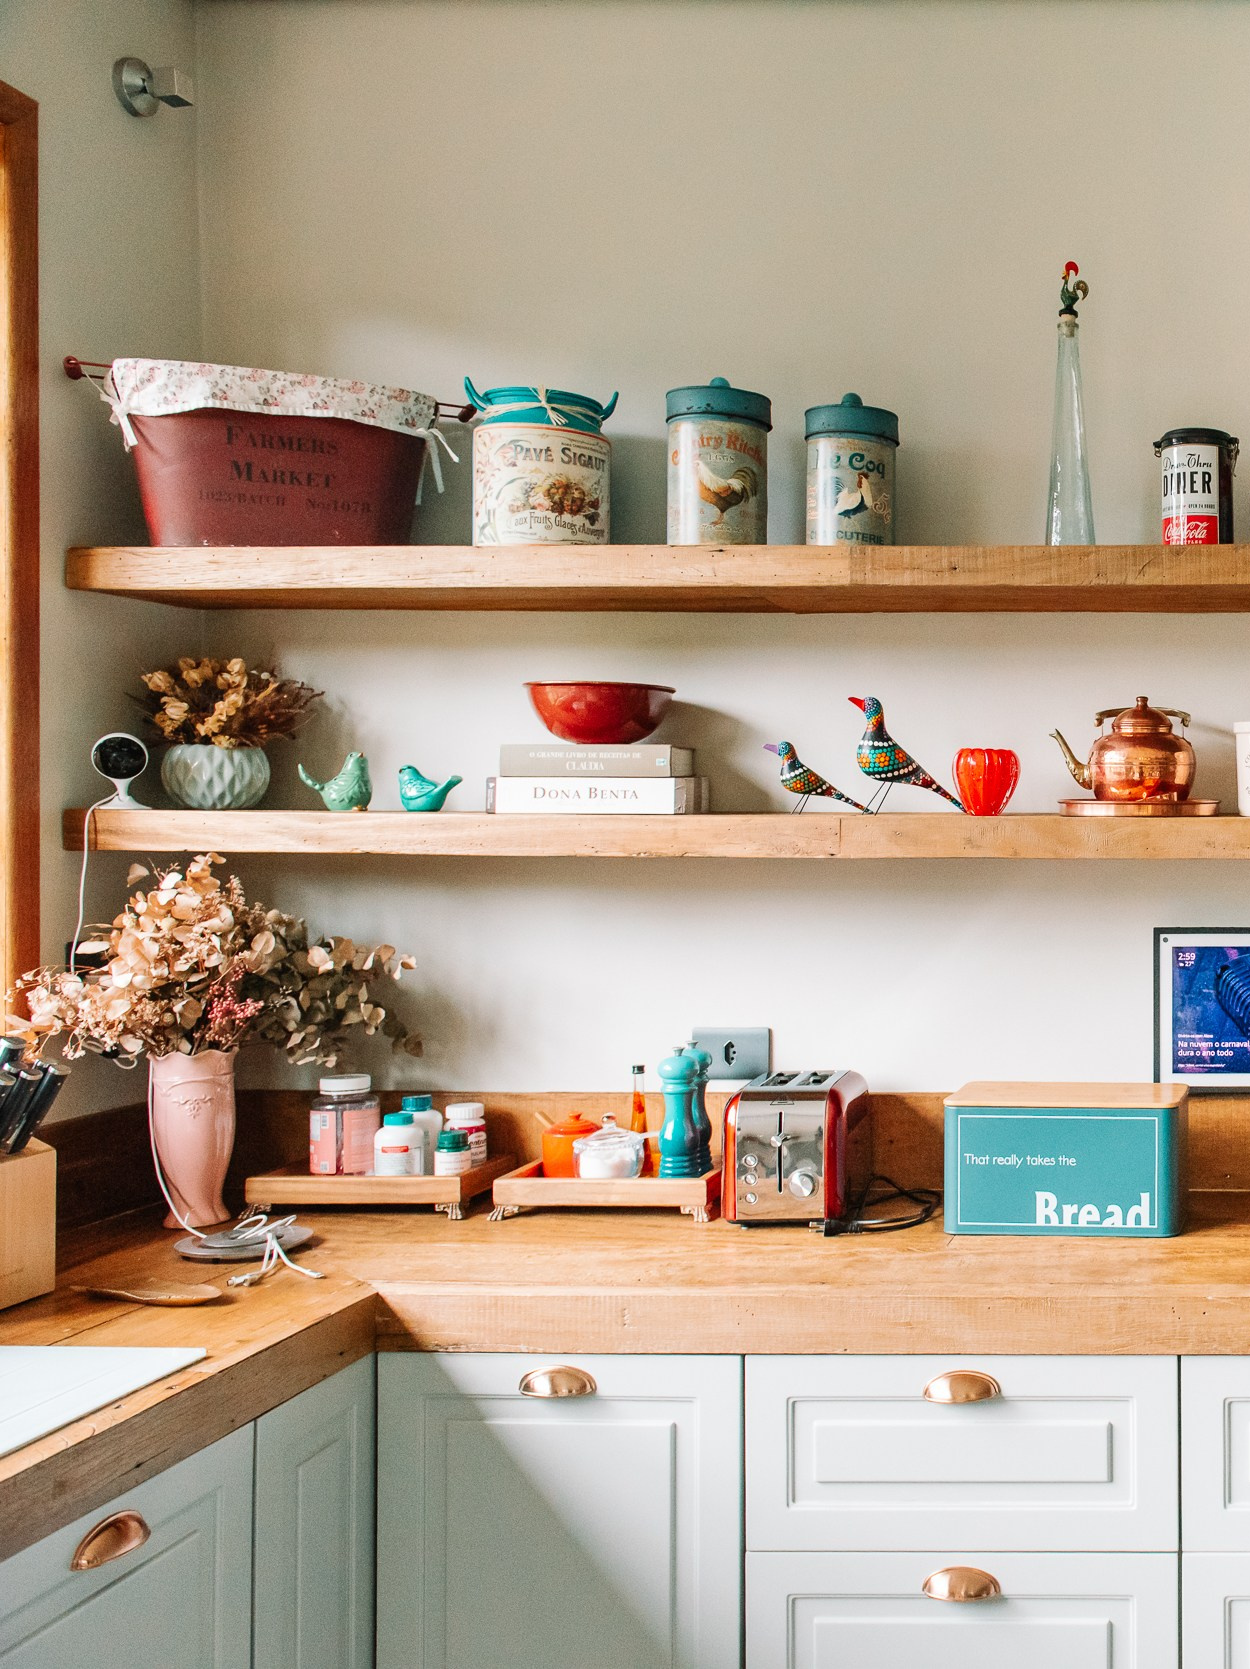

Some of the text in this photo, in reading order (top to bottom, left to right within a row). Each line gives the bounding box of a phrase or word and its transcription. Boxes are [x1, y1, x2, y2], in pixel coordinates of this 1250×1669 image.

[226, 421, 338, 455] FARMERS
[513, 443, 555, 463] PAVÉ
[561, 447, 606, 473] SIGAUT
[848, 452, 886, 480] Coq
[1163, 453, 1213, 472] Drve-Thru
[229, 459, 337, 488] MARKET
[1163, 470, 1212, 498] DINER
[529, 511, 553, 531] Fruits
[810, 529, 885, 545] CCUTERIE
[565, 761, 605, 771] CLAUDIA
[533, 786, 639, 799] DONA BENTA
[1177, 952, 1196, 961] 2:59
[1220, 1040, 1250, 1048] carnaval
[963, 1153, 1077, 1169] That really takes the
[1035, 1190, 1150, 1226] Bread
